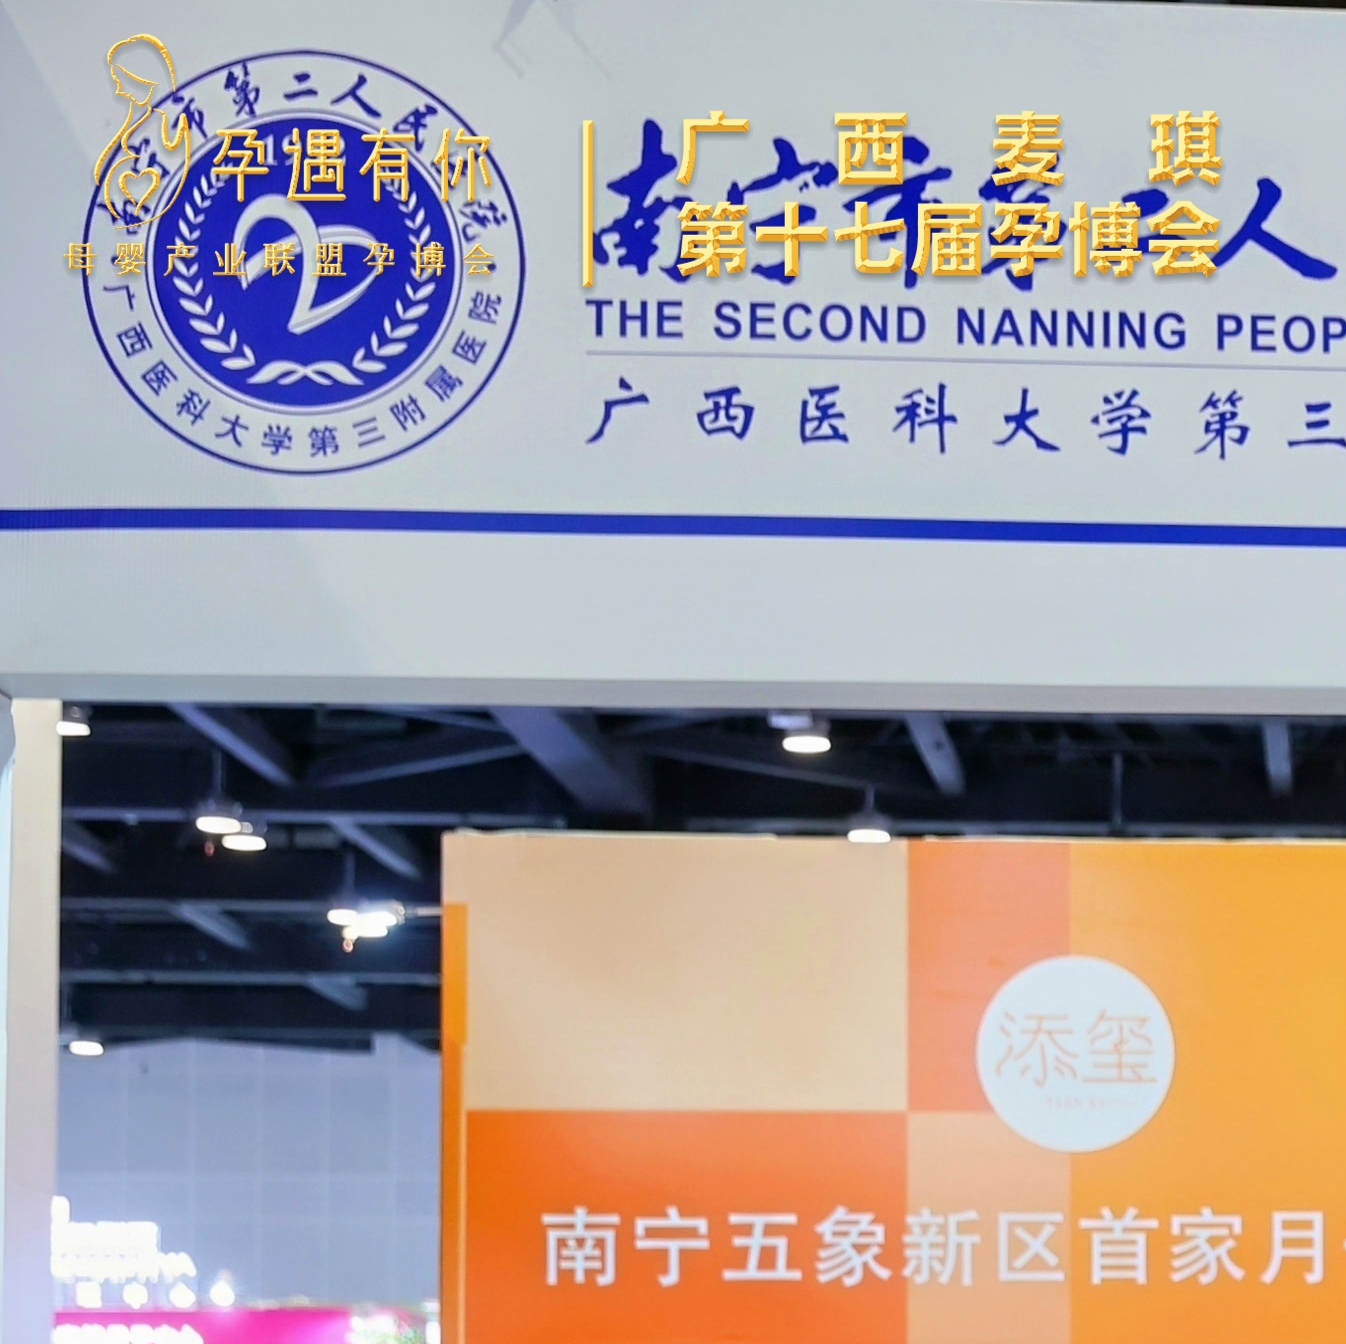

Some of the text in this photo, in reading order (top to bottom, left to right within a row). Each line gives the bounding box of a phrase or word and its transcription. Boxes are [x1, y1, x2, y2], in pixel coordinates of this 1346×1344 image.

[586, 299, 683, 339] THE
[712, 302, 927, 344] SECOND
[956, 307, 1188, 350] NANNING
[102, 282, 504, 459] 广西医科大学第三附属医院
[994, 1007, 1159, 1087] 添玺
